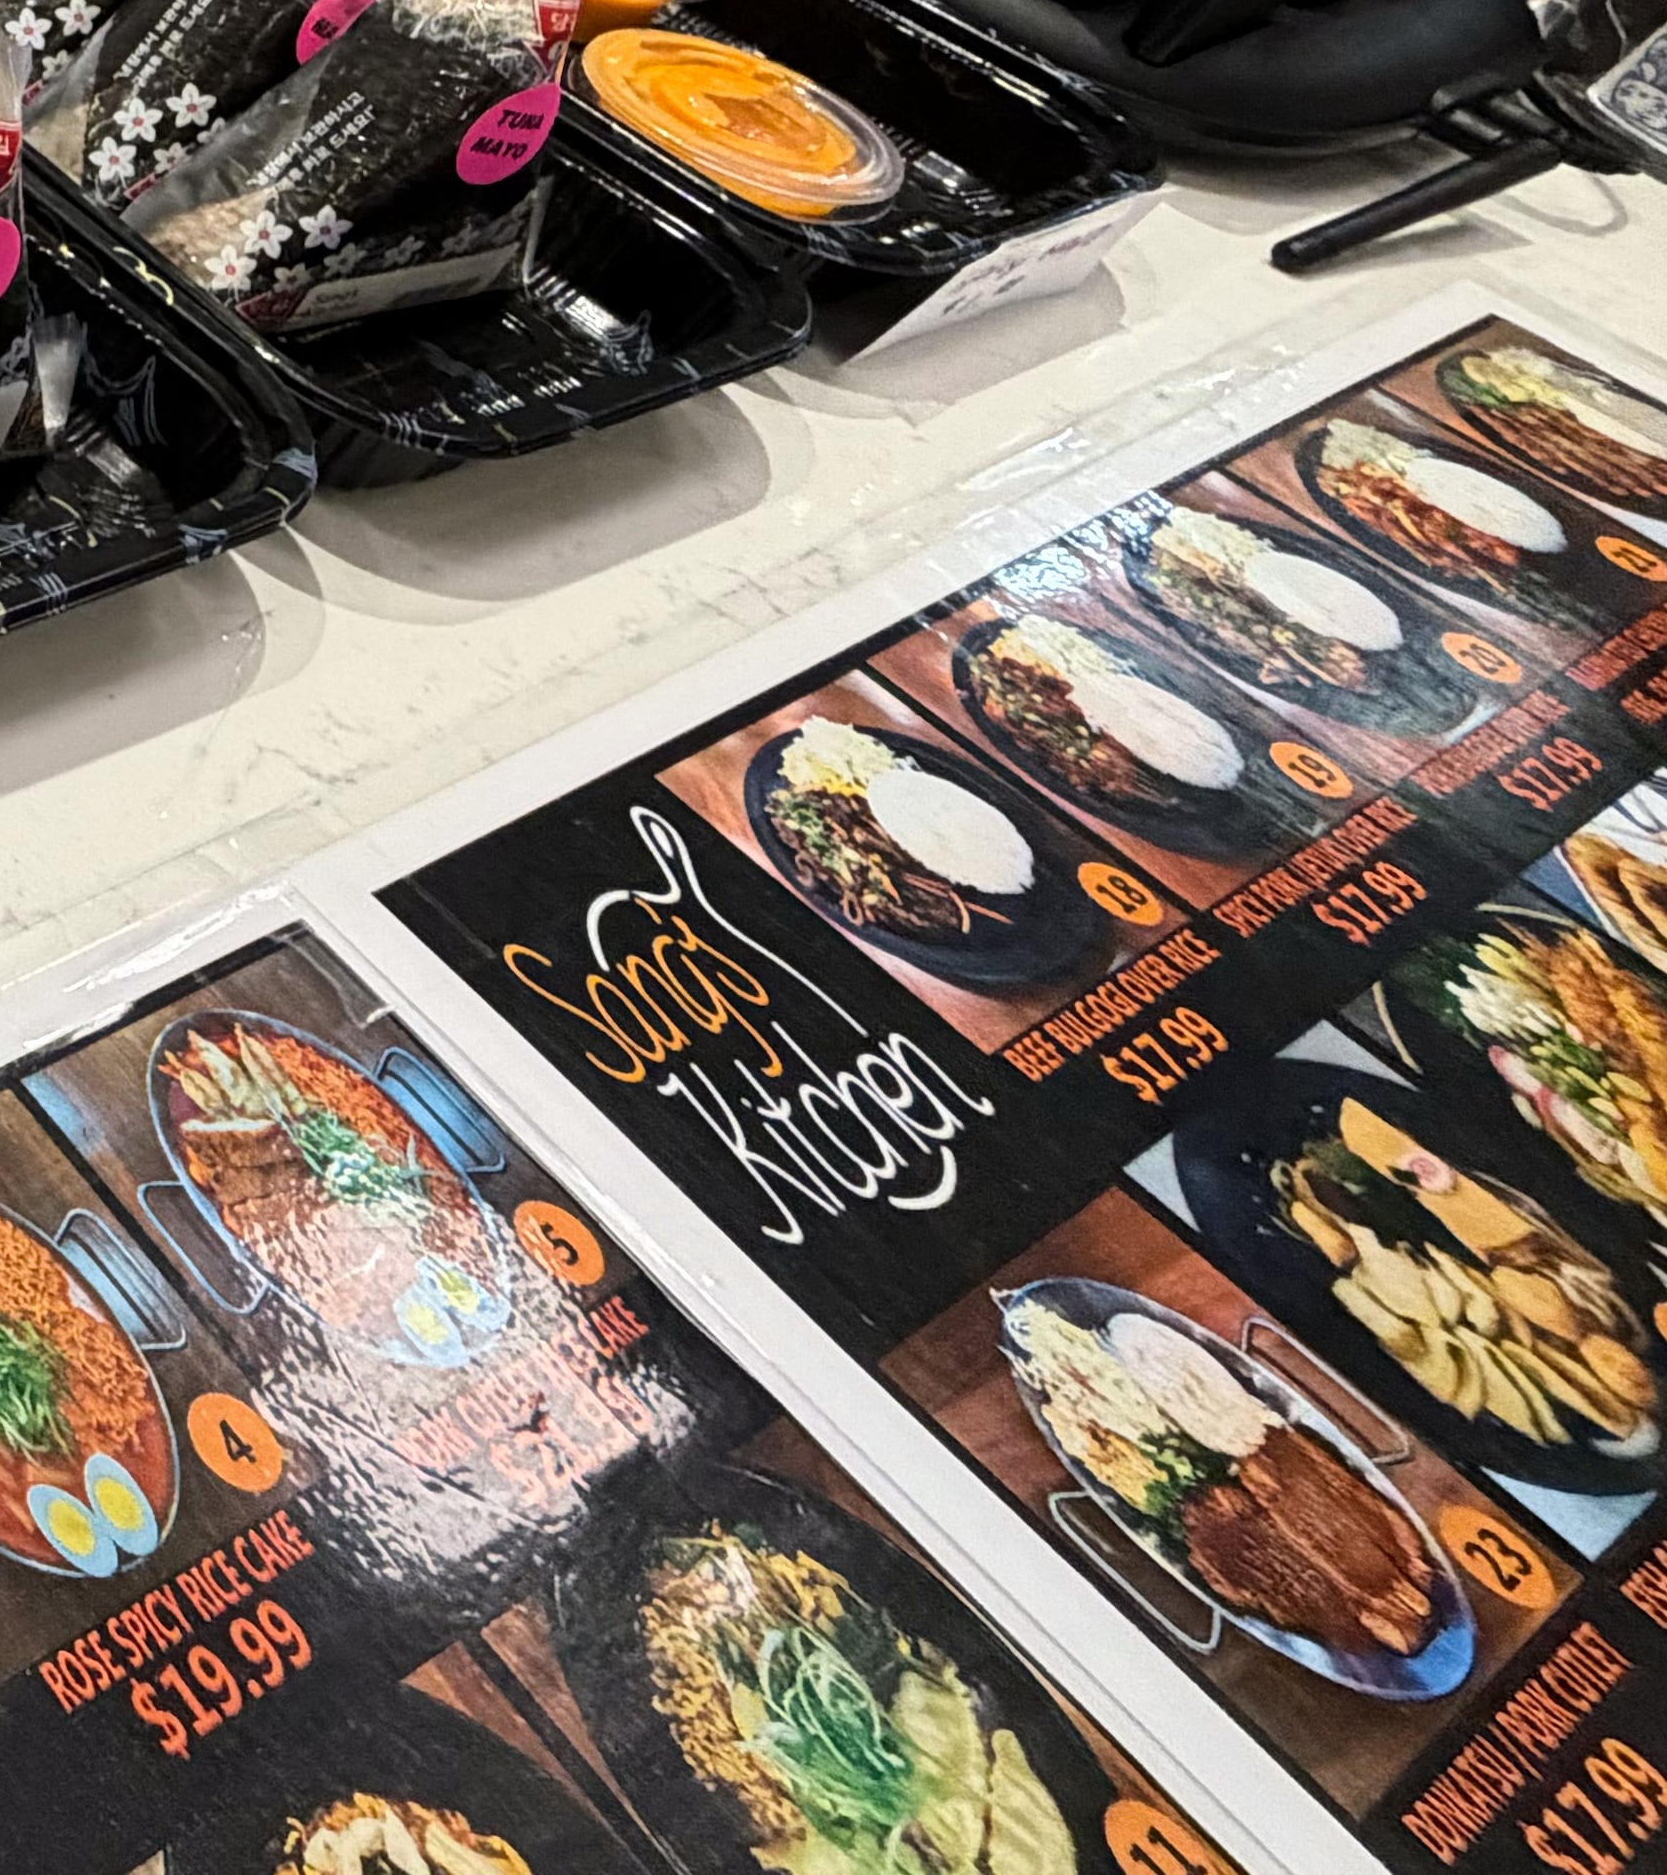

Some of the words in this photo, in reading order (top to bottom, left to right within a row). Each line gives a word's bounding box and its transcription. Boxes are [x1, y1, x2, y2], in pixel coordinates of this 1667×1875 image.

[469, 136, 530, 161] MAYO
[497, 109, 546, 131] TUNA
[1287, 753, 1338, 789] 19
[1496, 736, 1604, 813] $17.99
[1096, 876, 1148, 908] 18
[1310, 860, 1428, 947] $17.99
[1002, 1030, 1066, 1083] BEEF
[1042, 980, 1144, 1056] BULGOGI
[1117, 953, 1187, 1005] OVER
[1158, 928, 1223, 975] RICE
[1099, 1006, 1230, 1107] $17.99
[657, 1020, 995, 1246] Kitchen
[221, 1420, 254, 1463] 4
[1464, 1527, 1533, 1593] 23
[38, 1630, 127, 1715] ROSE
[106, 1583, 195, 1669] SPICY
[176, 1549, 254, 1623] RICE
[233, 1509, 315, 1583] CAKE
[130, 1599, 313, 1761] $19.99
[1400, 1732, 1527, 1867] DONKATSU
[1495, 1677, 1583, 1762] PORK
[1539, 1620, 1637, 1715] CUTLET
[1520, 1737, 1667, 1875] $17.99
